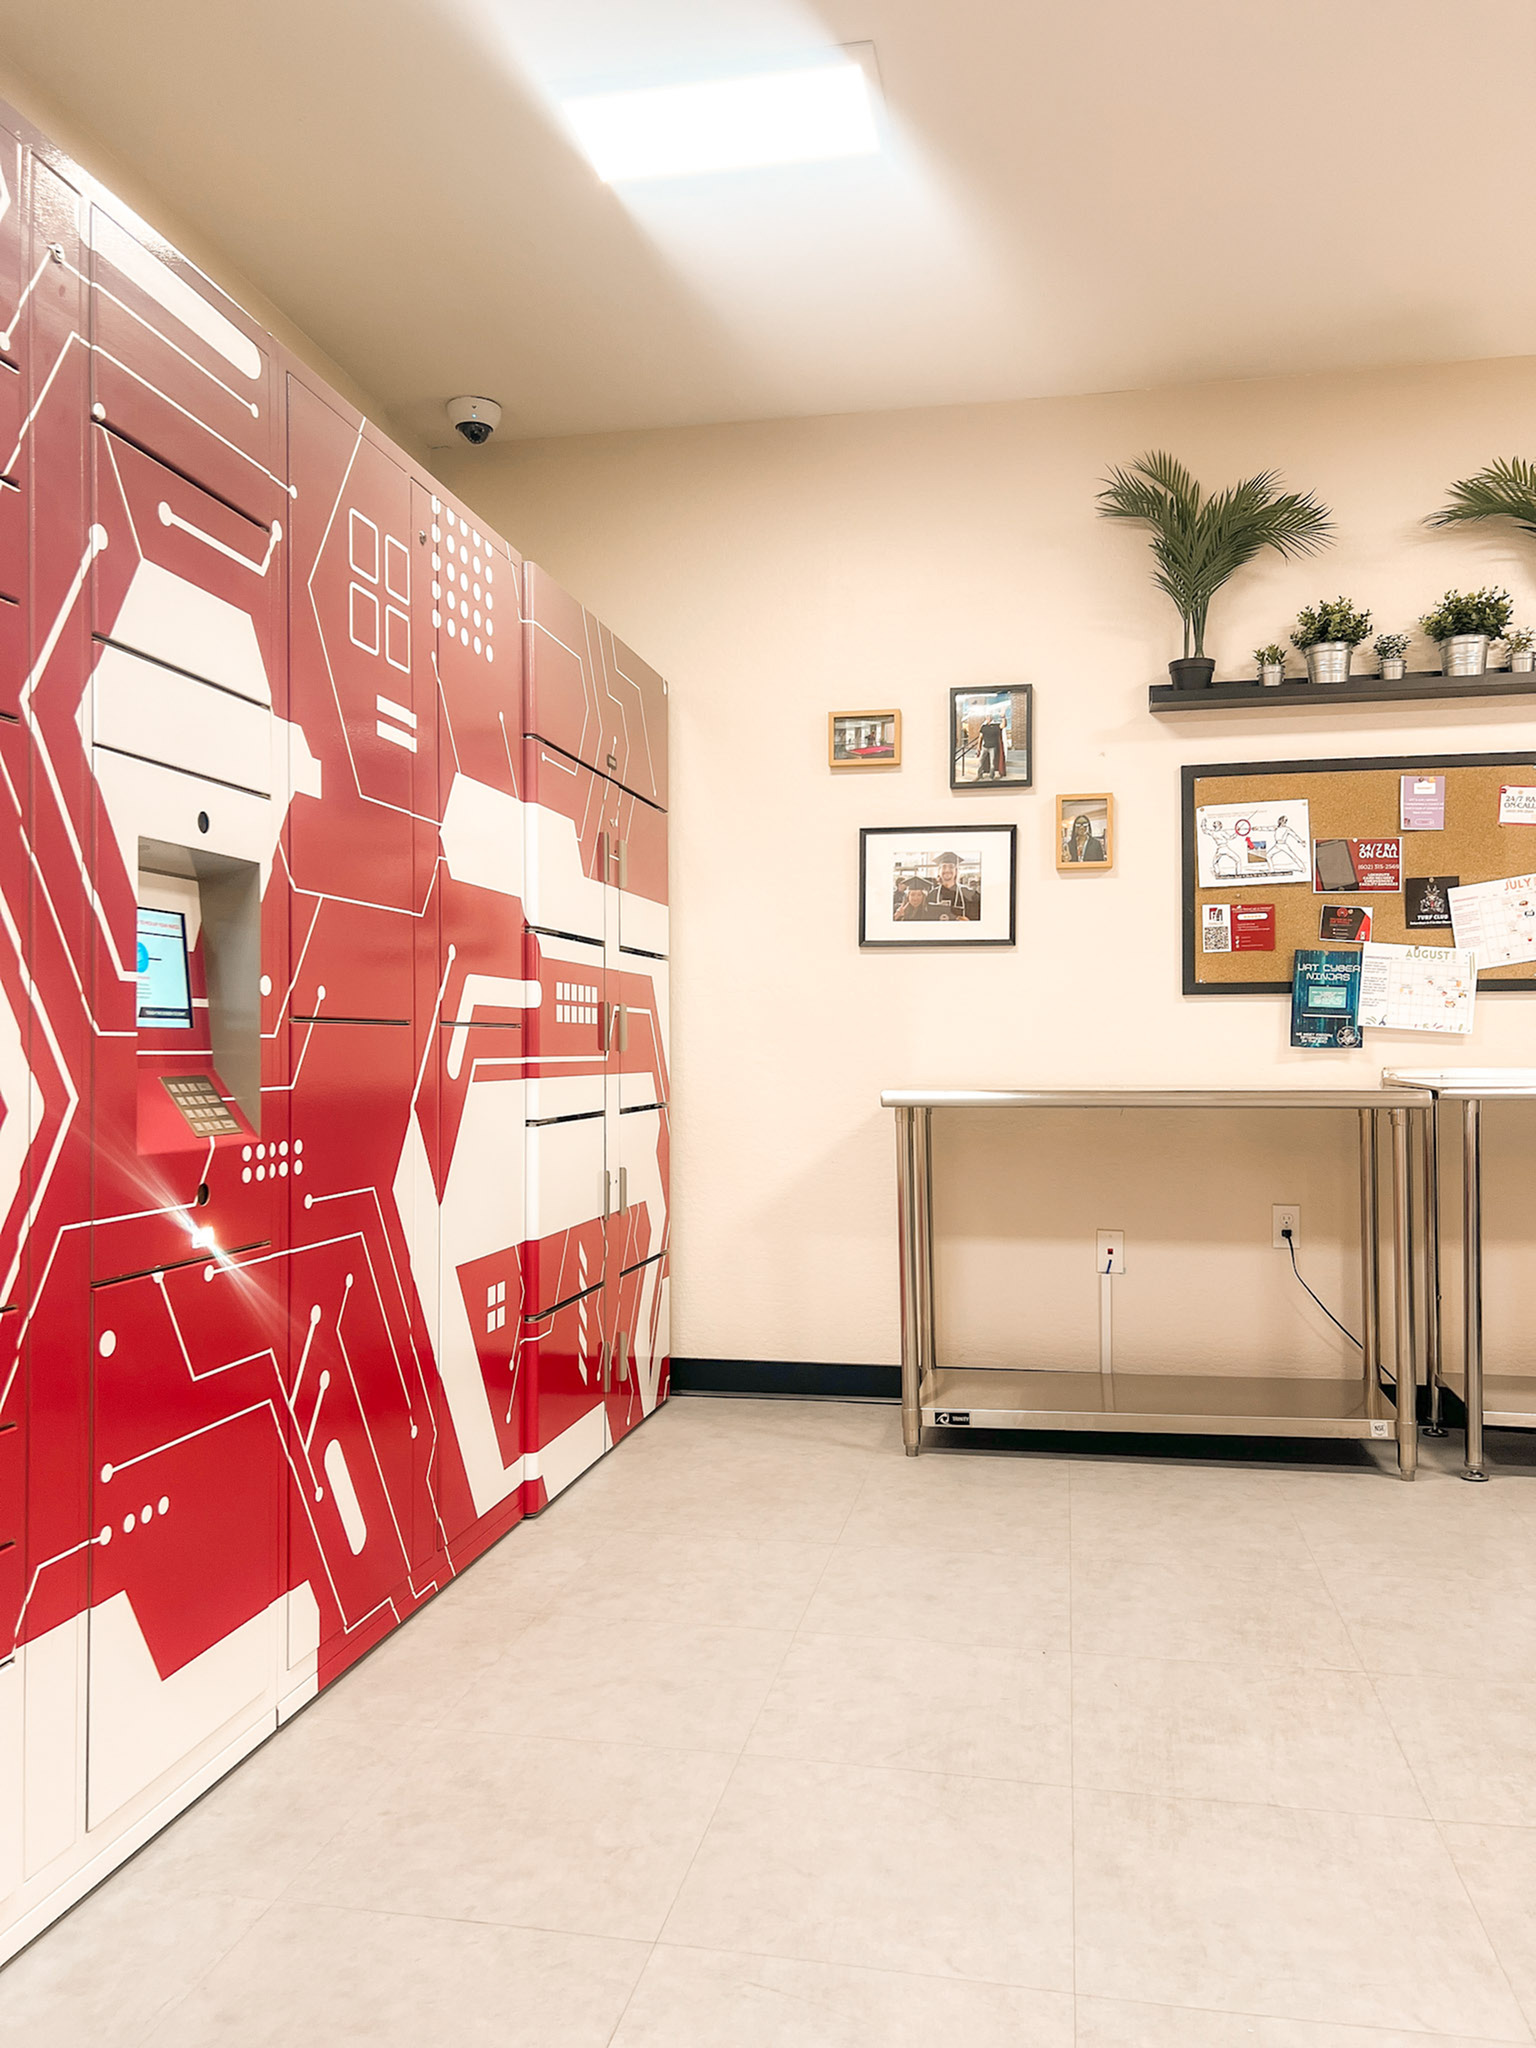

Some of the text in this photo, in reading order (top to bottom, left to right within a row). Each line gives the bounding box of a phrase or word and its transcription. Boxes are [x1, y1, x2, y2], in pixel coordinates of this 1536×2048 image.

[1505, 795, 1523, 804] 24/7
[1359, 843, 1398, 853] 24/7 RA
[1359, 850, 1399, 859] ON CALL
[1504, 877, 1531, 892] JULY
[1405, 948, 1450, 960] AUGUST
[1297, 963, 1361, 973] UAT CYBER
[1306, 972, 1351, 982] NINJAS
